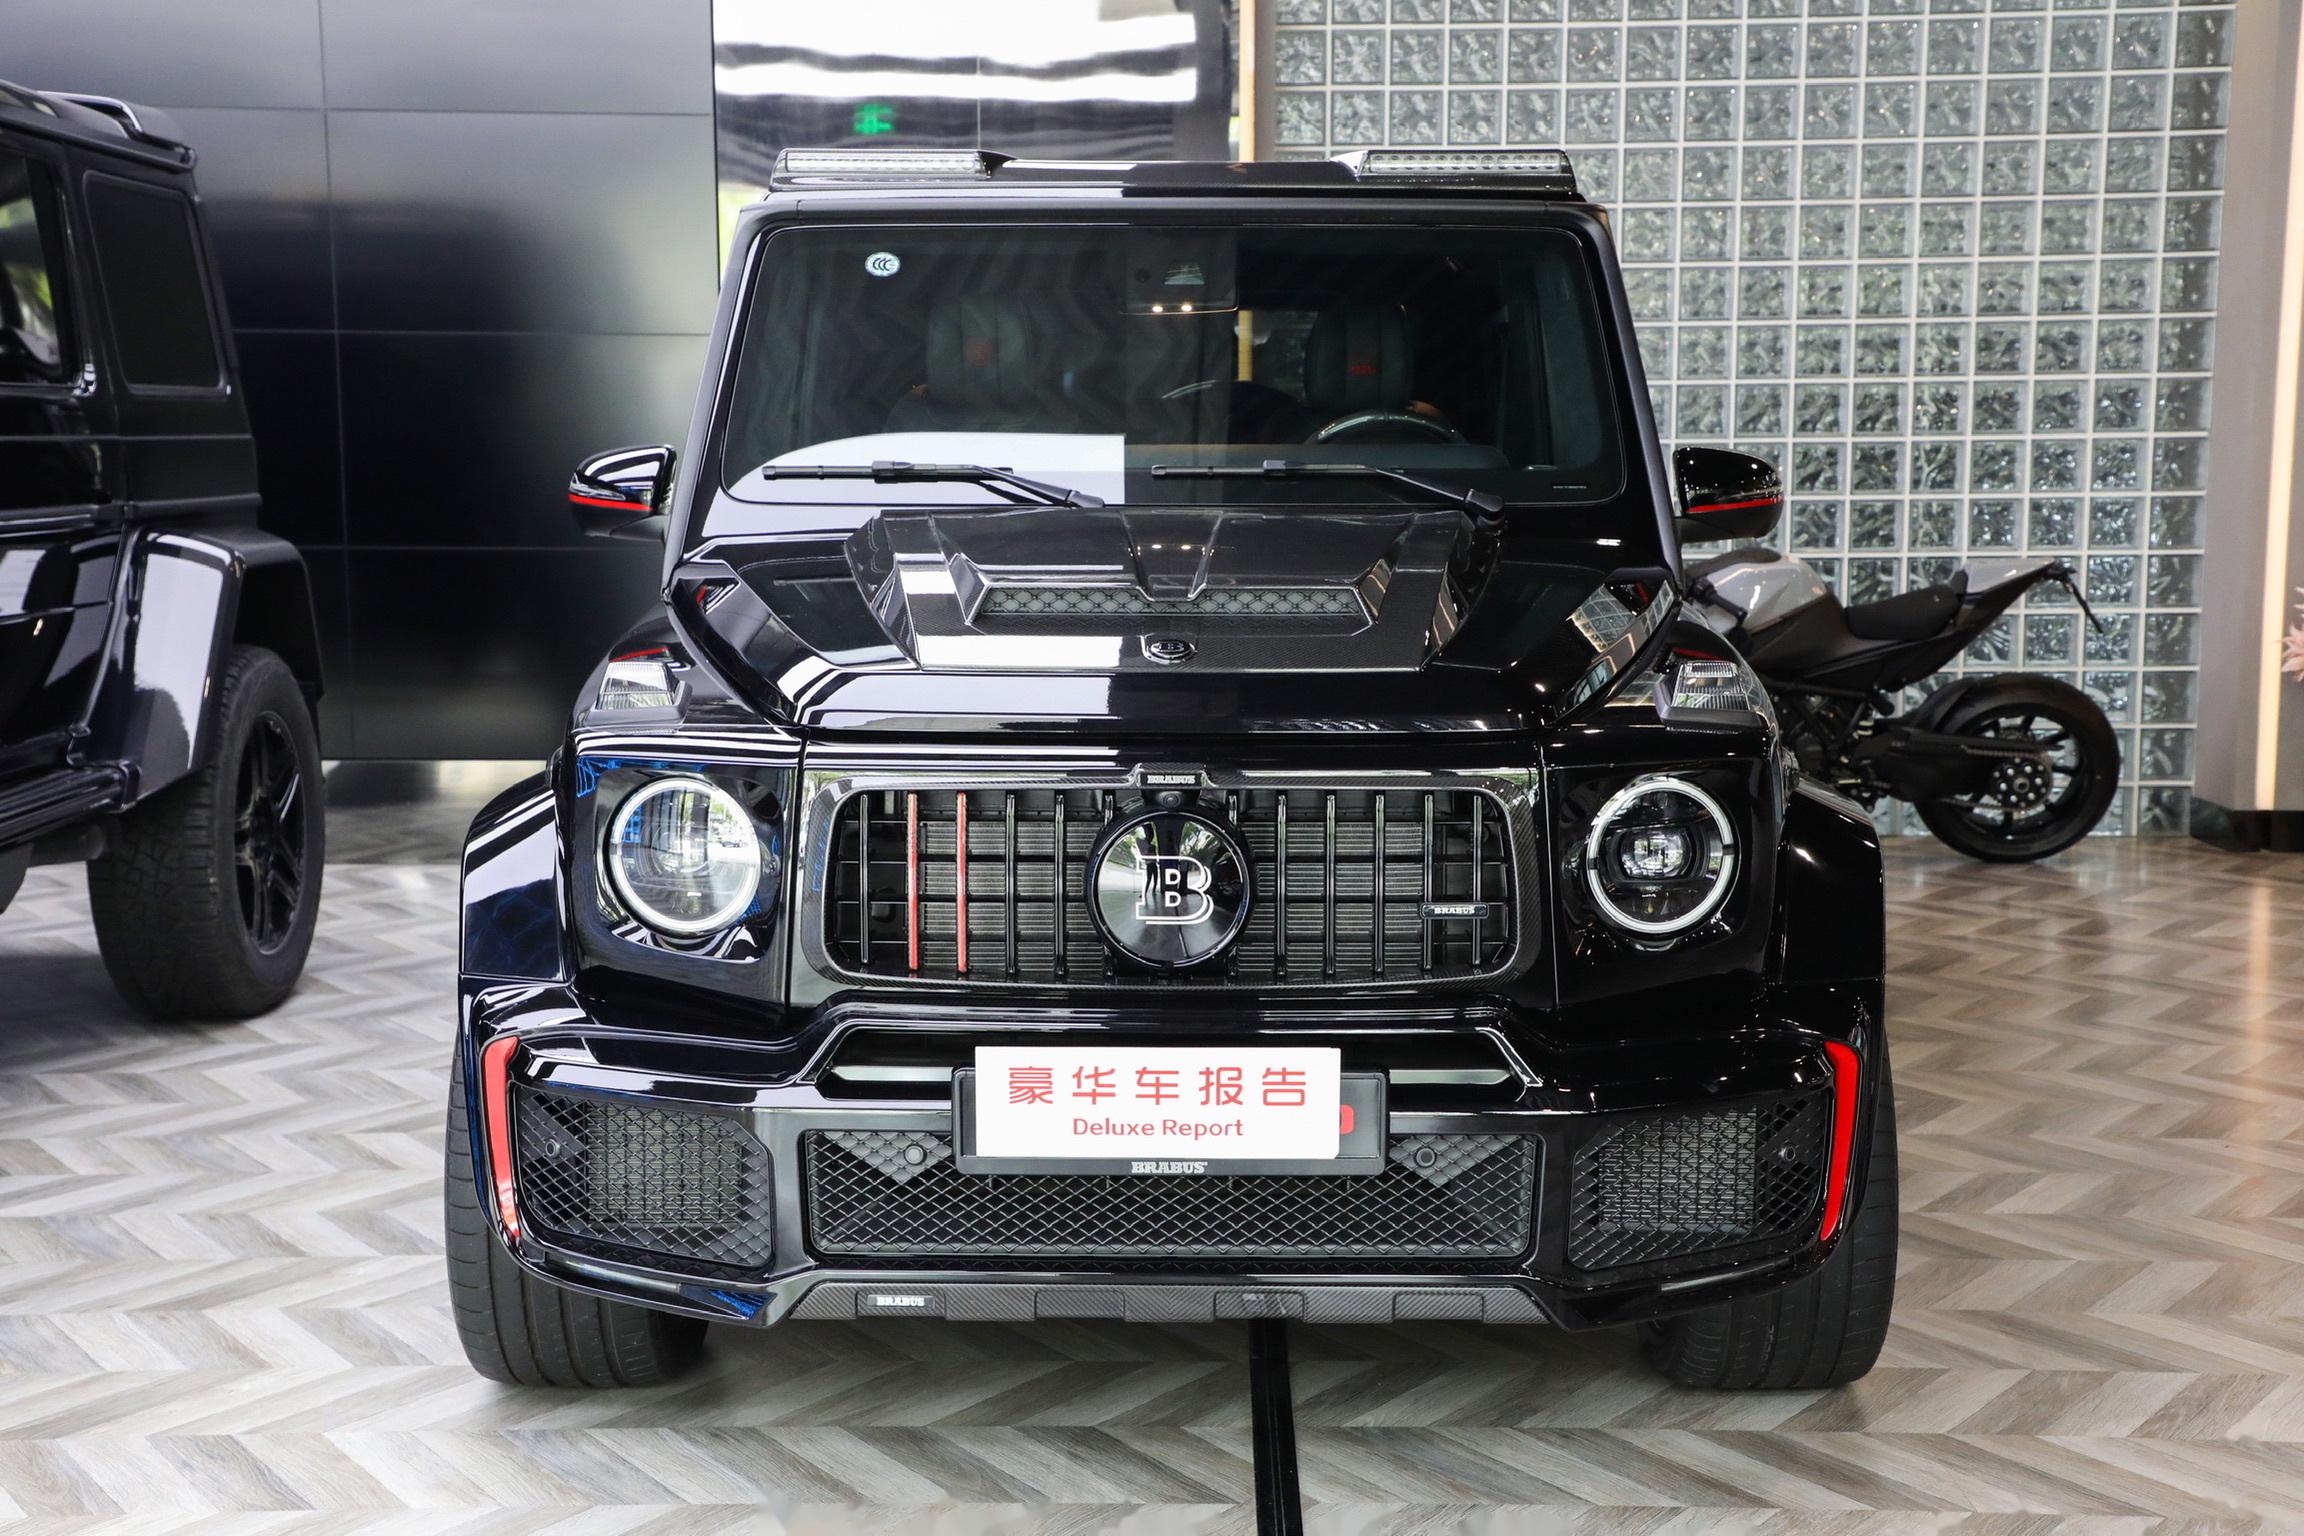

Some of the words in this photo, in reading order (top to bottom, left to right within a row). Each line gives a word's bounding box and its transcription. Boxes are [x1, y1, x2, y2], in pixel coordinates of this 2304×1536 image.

[1147, 774, 1196, 785] BRABUS
[1008, 1066, 1307, 1107] 豪华车报告
[1072, 1118, 1155, 1137] Deluxe
[1162, 1119, 1244, 1141] Report
[1131, 1161, 1208, 1174] BRABUS
[876, 1296, 925, 1307] BRABUS
